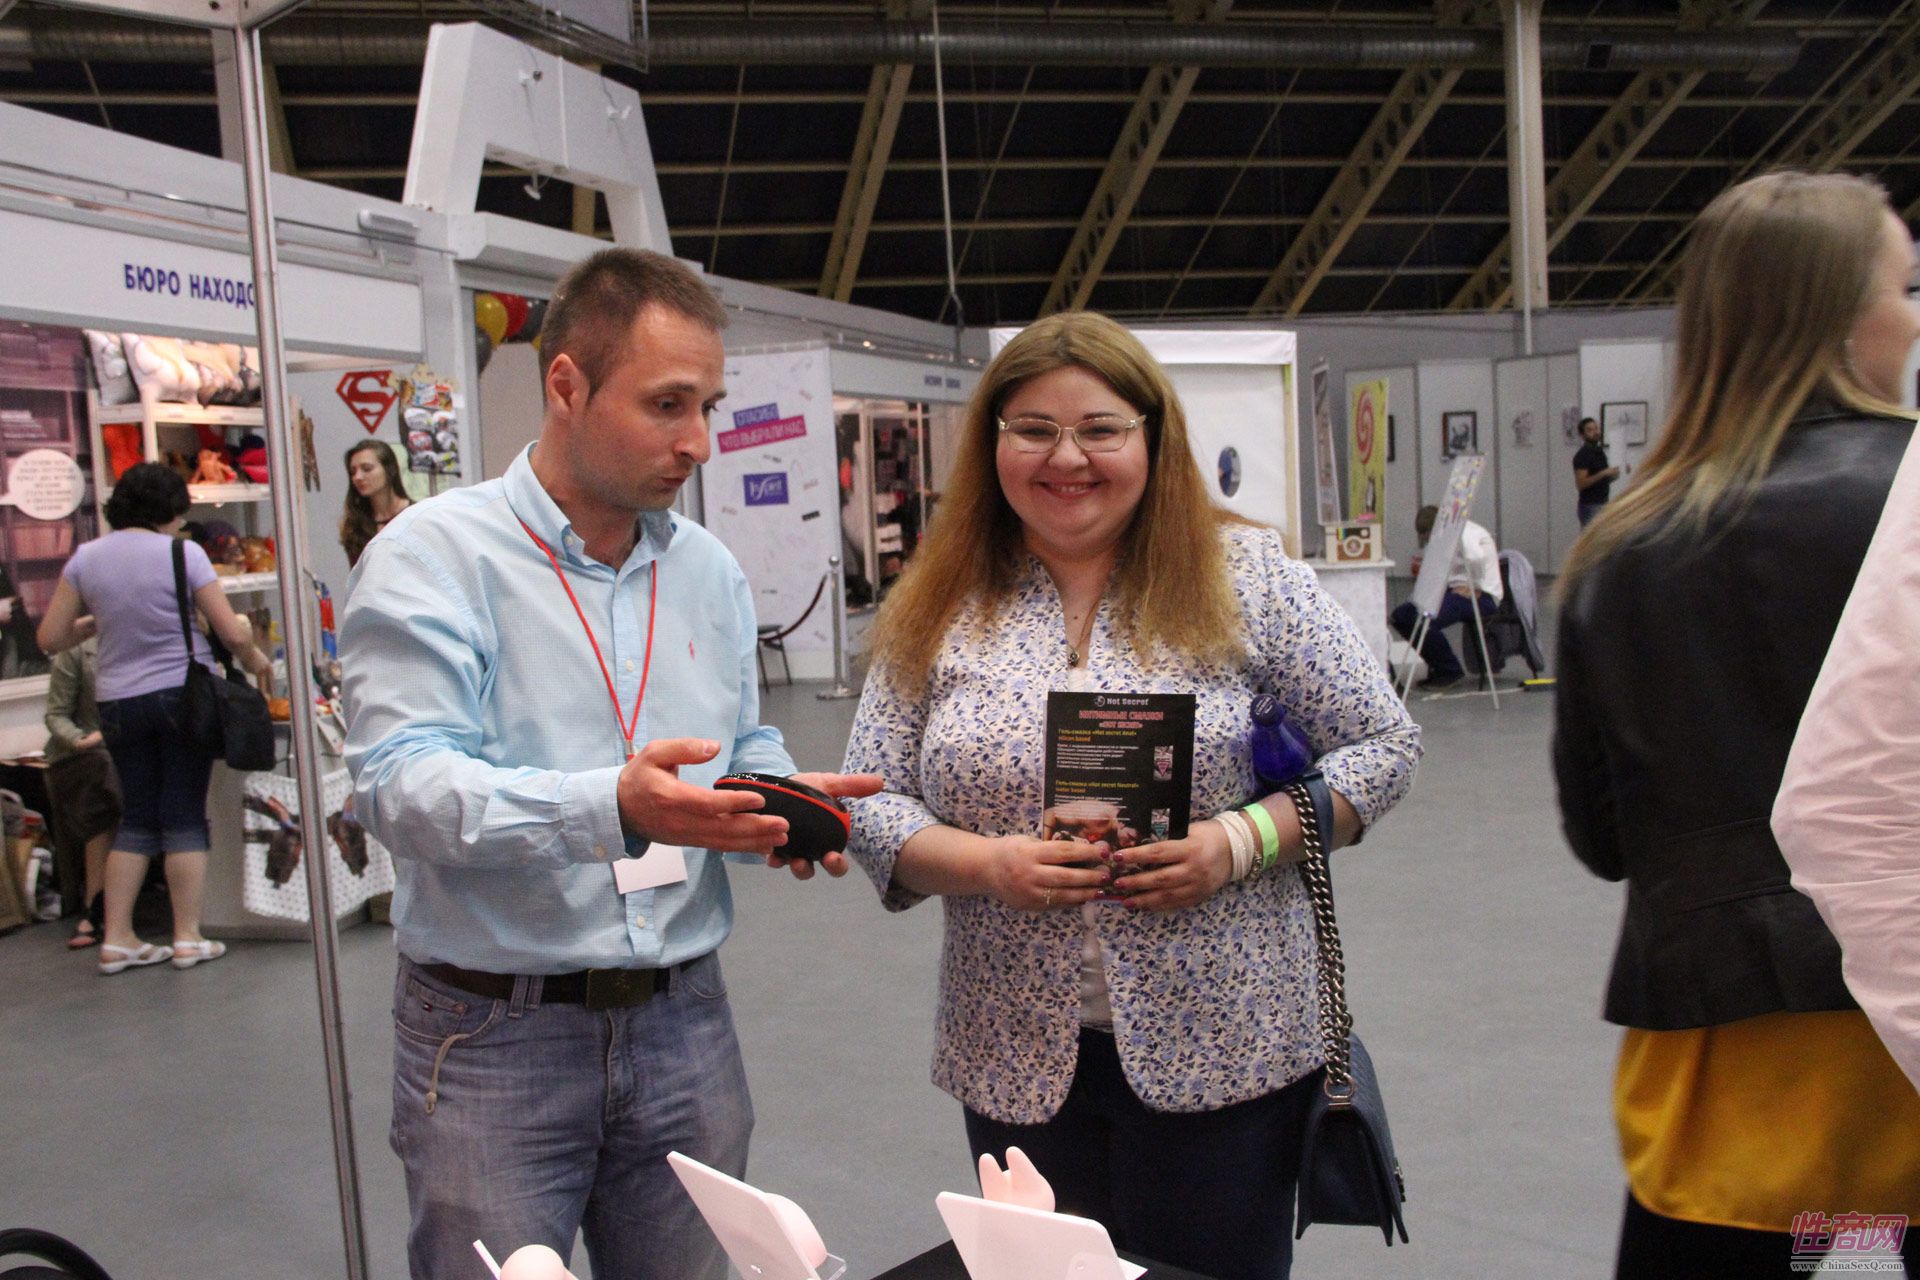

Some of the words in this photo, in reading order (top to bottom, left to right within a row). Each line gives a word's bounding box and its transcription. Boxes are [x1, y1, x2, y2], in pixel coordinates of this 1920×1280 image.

[124, 263, 181, 296] БЮРО
[189, 273, 256, 310] НАХОДО
[1122, 698, 1150, 706] Secret
